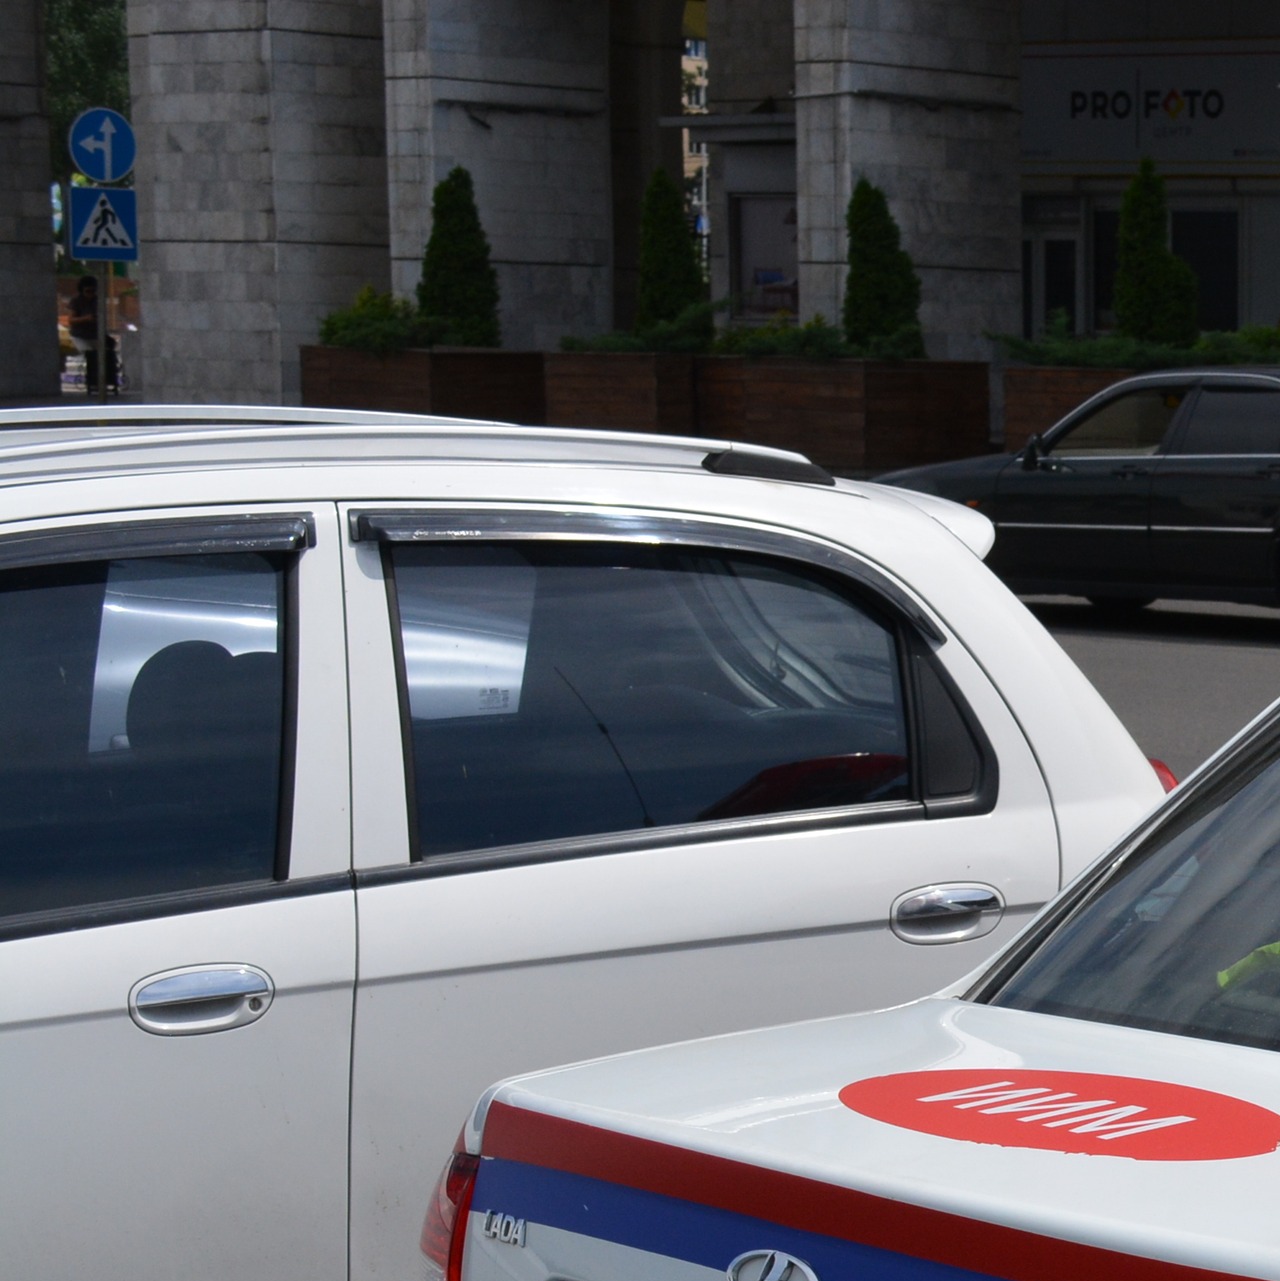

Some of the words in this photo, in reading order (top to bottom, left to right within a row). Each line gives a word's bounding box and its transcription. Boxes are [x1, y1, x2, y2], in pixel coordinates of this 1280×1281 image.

[1070, 90, 1131, 119] PRO
[915, 1080, 1198, 1140] ИИМ
[482, 1209, 527, 1248] LADA
